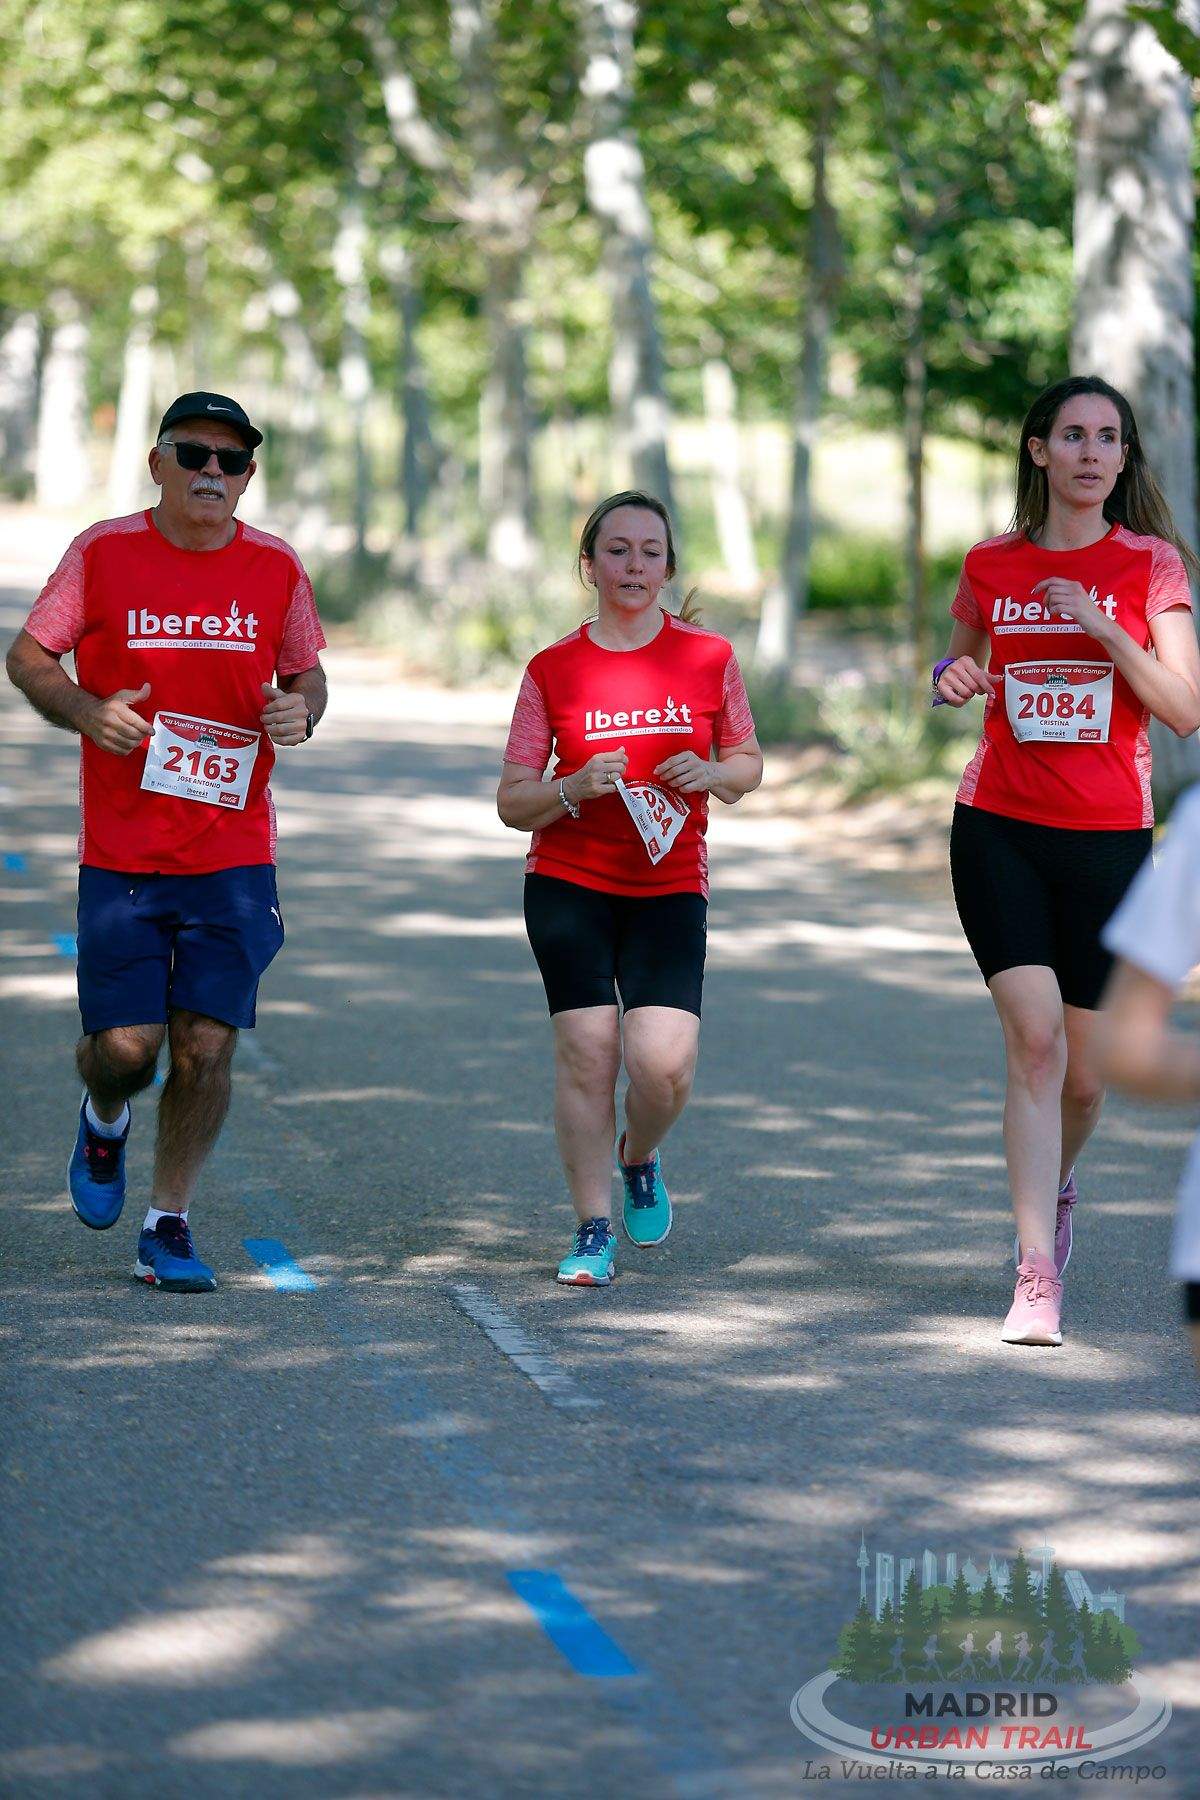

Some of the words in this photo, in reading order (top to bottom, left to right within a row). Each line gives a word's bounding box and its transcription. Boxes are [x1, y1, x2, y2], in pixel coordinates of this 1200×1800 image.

[992, 593, 1117, 622] Ibet
[127, 607, 258, 639] Iberext
[129, 640, 178, 648] Protección
[182, 640, 213, 648] Contra
[217, 641, 254, 651] Incendios
[1082, 668, 1107, 676] Campo
[585, 703, 692, 731] Iberext
[1017, 692, 1096, 720] 2084
[174, 720, 194, 729] Vuelta
[209, 728, 223, 736] Casa
[223, 730, 231, 738] de
[163, 745, 240, 784] 2163
[177, 775, 192, 784] JOSE
[193, 778, 221, 789] ANTONIO
